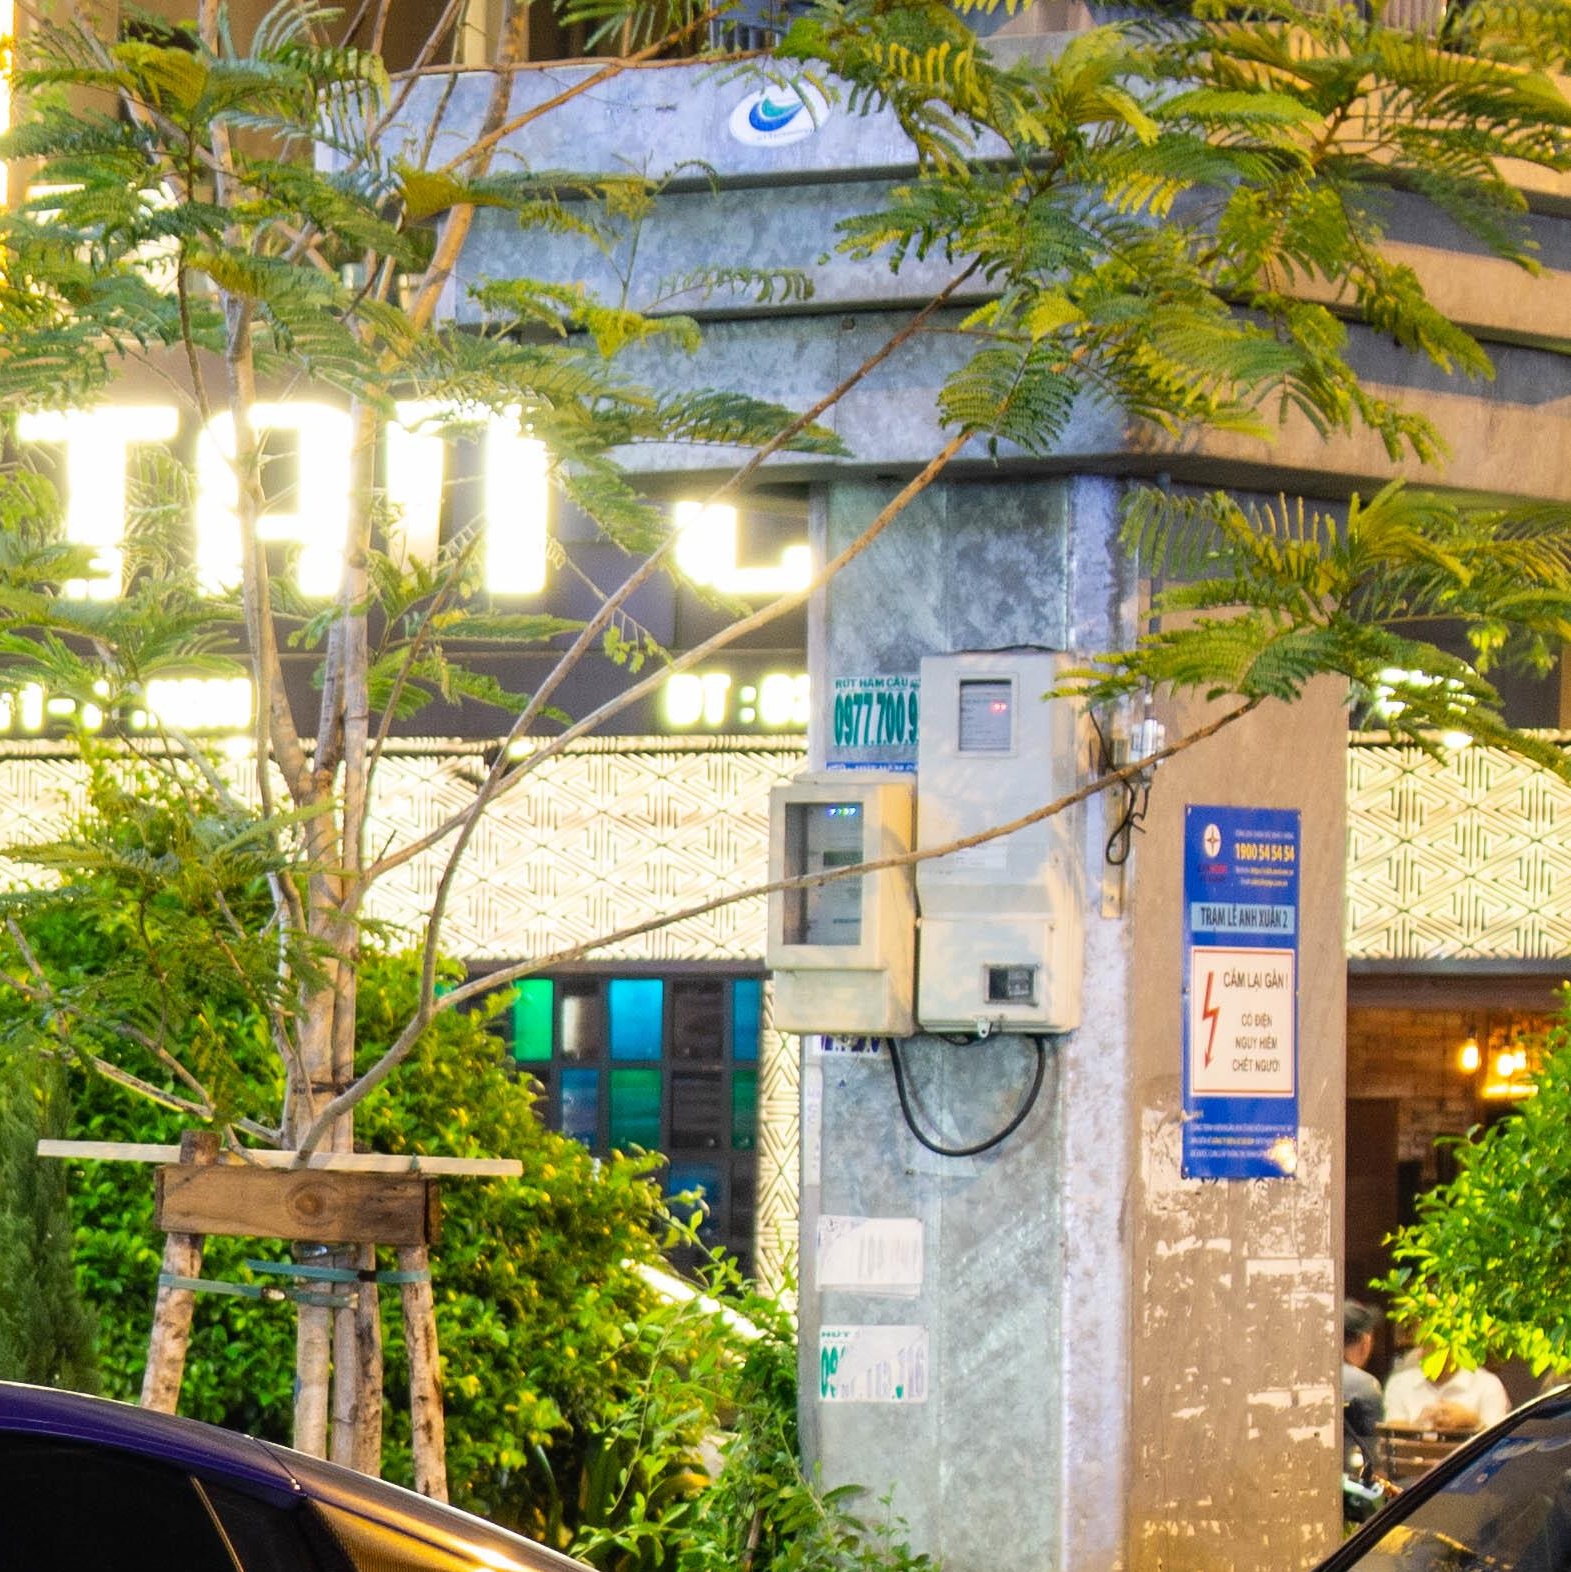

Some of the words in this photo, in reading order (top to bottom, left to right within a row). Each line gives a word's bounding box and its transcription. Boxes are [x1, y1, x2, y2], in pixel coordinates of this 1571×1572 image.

[834, 691, 919, 746] 0977.700.9
[1235, 843, 1257, 860] 1900
[1259, 844, 1270, 861] 54
[1272, 844, 1283, 861] 54
[1284, 845, 1295, 862] 54
[1239, 907, 1256, 927] ANH
[1283, 911, 1288, 928] 2
[1235, 1036, 1257, 1049] NGUY
